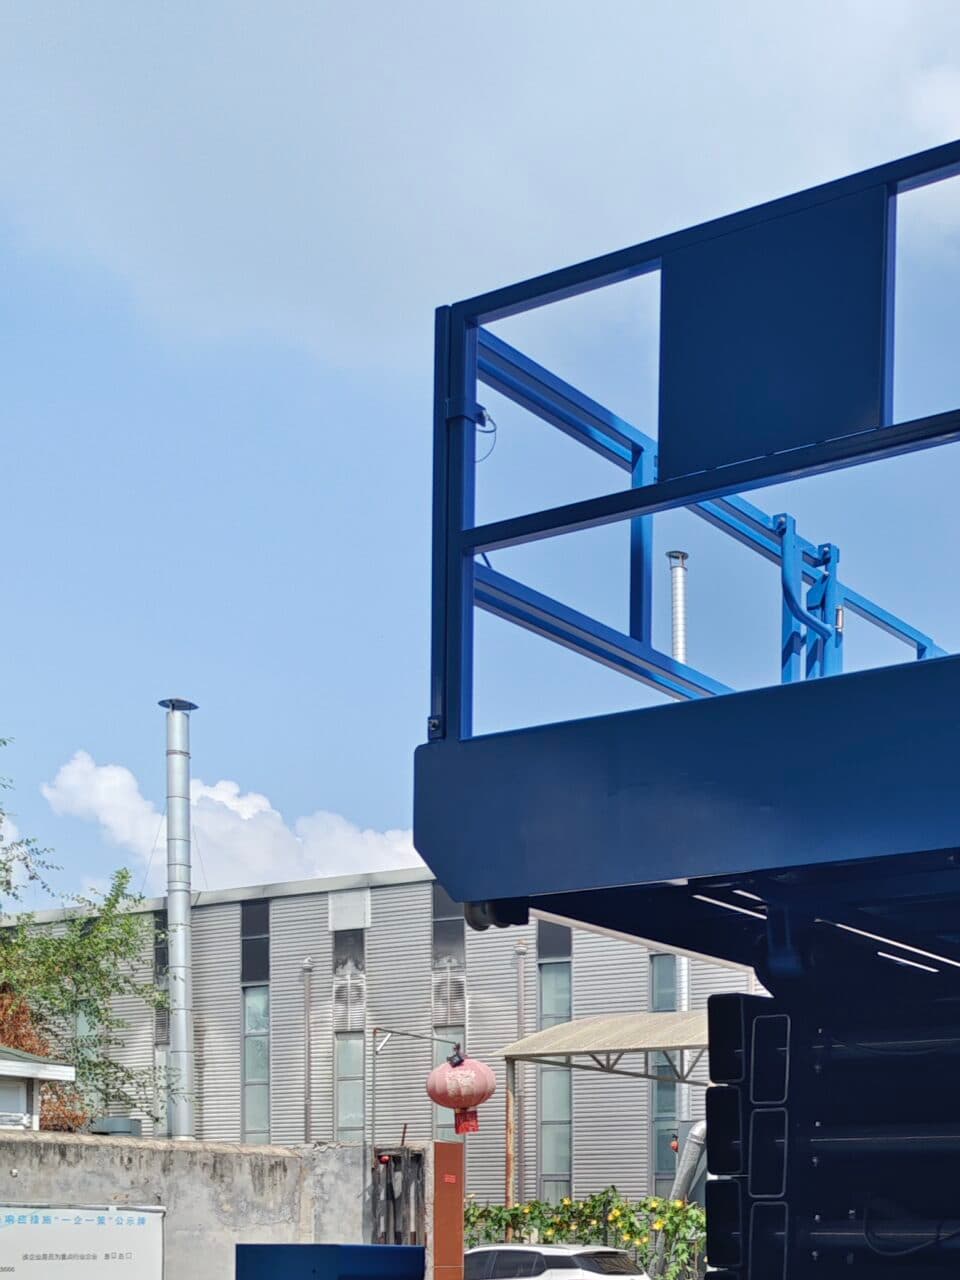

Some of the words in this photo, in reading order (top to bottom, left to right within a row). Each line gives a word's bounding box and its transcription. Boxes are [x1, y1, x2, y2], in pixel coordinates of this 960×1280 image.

[0, 1214, 147, 1226] 响应措施“一企一策”公示牌
